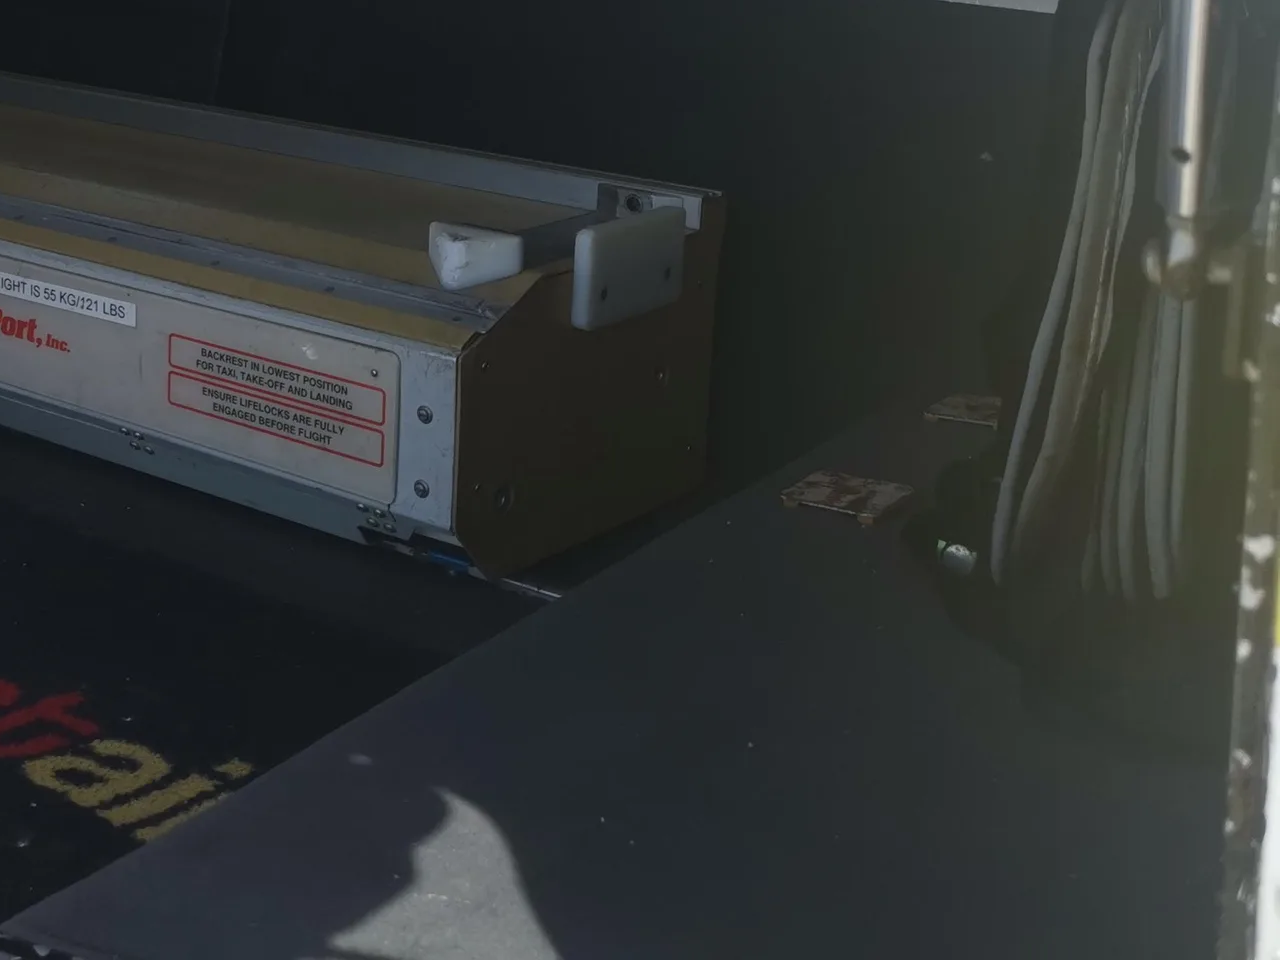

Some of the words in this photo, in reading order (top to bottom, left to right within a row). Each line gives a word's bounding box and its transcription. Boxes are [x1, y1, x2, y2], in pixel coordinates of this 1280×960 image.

[30, 284, 41, 298] IS
[43, 287, 57, 302] 55
[59, 291, 99, 312] KG/121
[102, 301, 126, 319] LBS
[196, 359, 214, 372] FOR
[216, 364, 238, 380] TAXI,
[240, 371, 286, 391] TAKE-OFF
[287, 384, 308, 398] AND
[309, 390, 353, 411] LANDING
[201, 347, 249, 369] BACKREST
[250, 361, 260, 372] IN
[262, 364, 301, 382] LOWEST
[303, 375, 348, 396] POSITION
[202, 386, 238, 405] ENSURE
[239, 398, 291, 421] LIFELOCKS
[292, 413, 312, 427] ARE
[313, 419, 345, 436] FULLY
[212, 402, 257, 423] ENGAGED
[258, 415, 296, 435] BEFORE
[298, 427, 332, 446] FLIGHT
